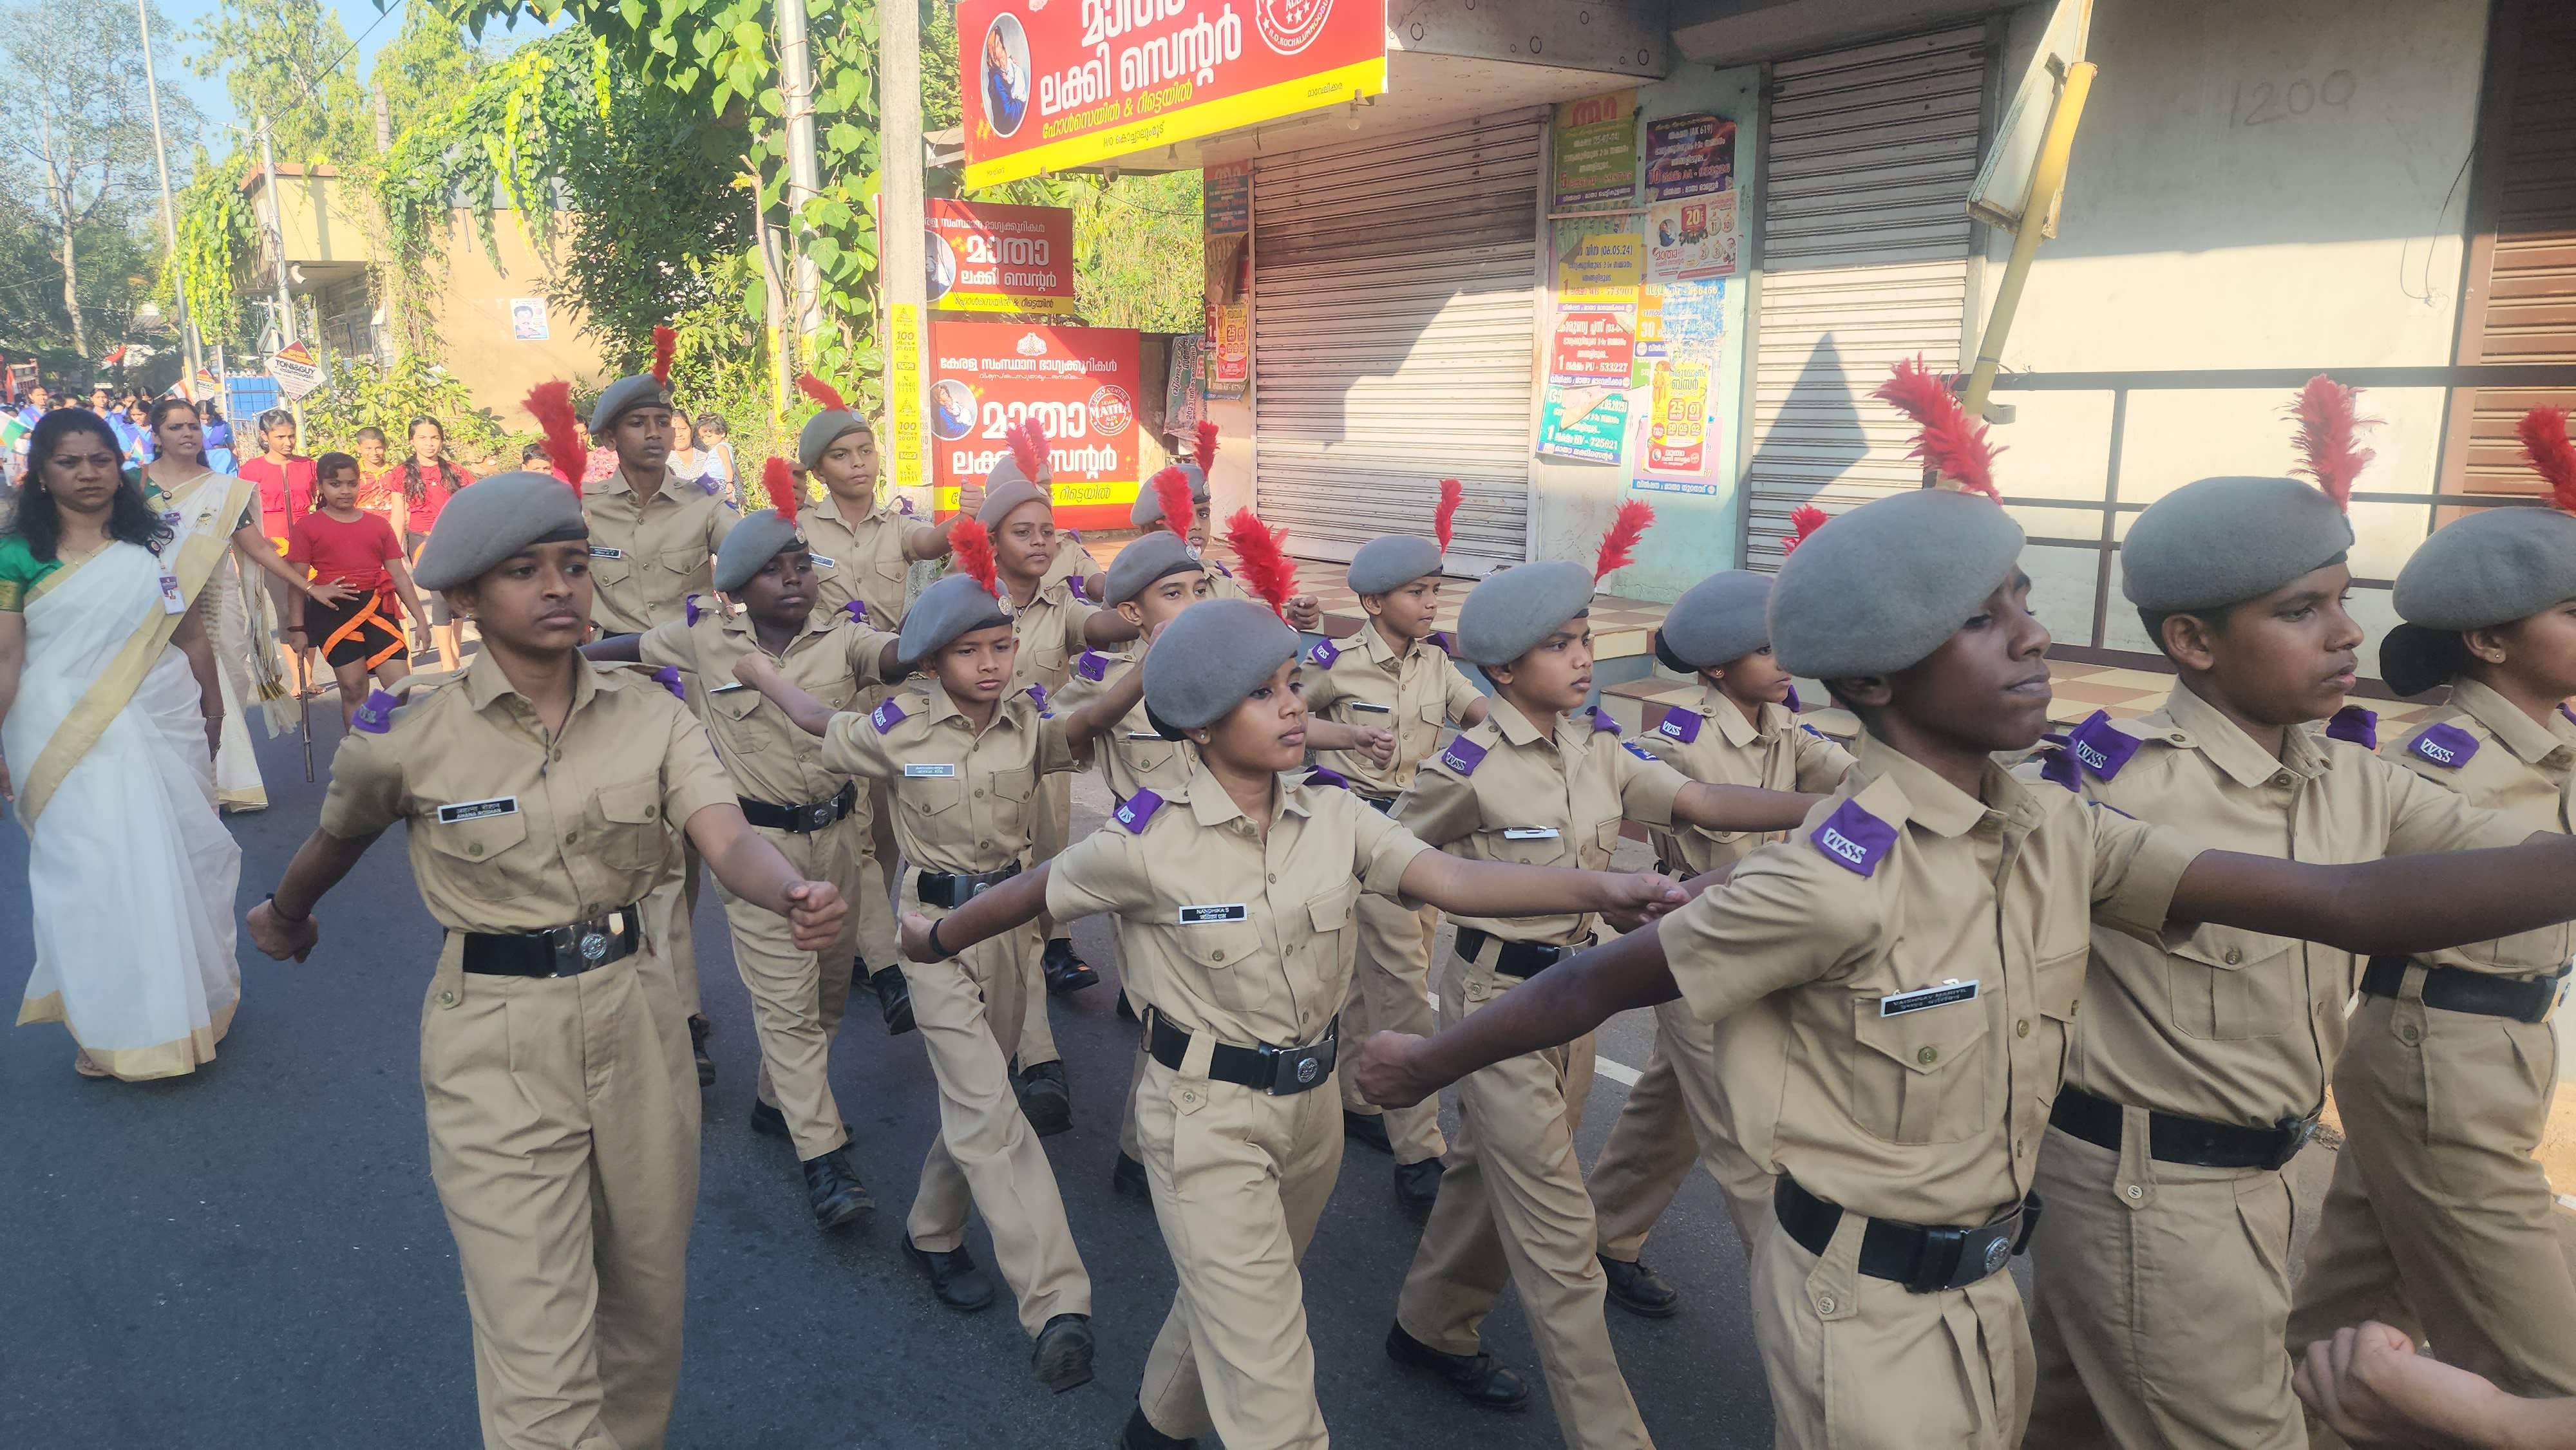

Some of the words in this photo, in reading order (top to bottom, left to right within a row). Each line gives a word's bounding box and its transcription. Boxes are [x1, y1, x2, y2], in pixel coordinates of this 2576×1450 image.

[1041, 42, 1112, 117] ലക്കി
[1124, 97, 1134, 118] &
[1560, 171, 1568, 189] 5
[1686, 209, 1700, 226] 20
[966, 234, 1049, 266] മാതാ
[961, 267, 999, 287] ലക്കി
[897, 331, 914, 340] 100
[940, 357, 979, 372] കേരള
[981, 358, 1036, 372] സംസ്ഥാന
[1039, 357, 1117, 374] ഭാഗ്യക്കുറികൾ
[1558, 355, 1564, 370] 1
[1585, 362, 1595, 372] PU
[1600, 362, 1629, 372] 533227
[1092, 388, 1106, 406] LUCKY
[1107, 387, 1127, 399] CENTRE
[1089, 400, 1132, 419] MATHA
[1670, 401, 1684, 414] 25
[1689, 404, 1700, 414] 01
[899, 422, 916, 430] 100
[981, 401, 1086, 440] മാതാ
[1548, 425, 1555, 440] 1
[1589, 437, 1618, 450] 725621
